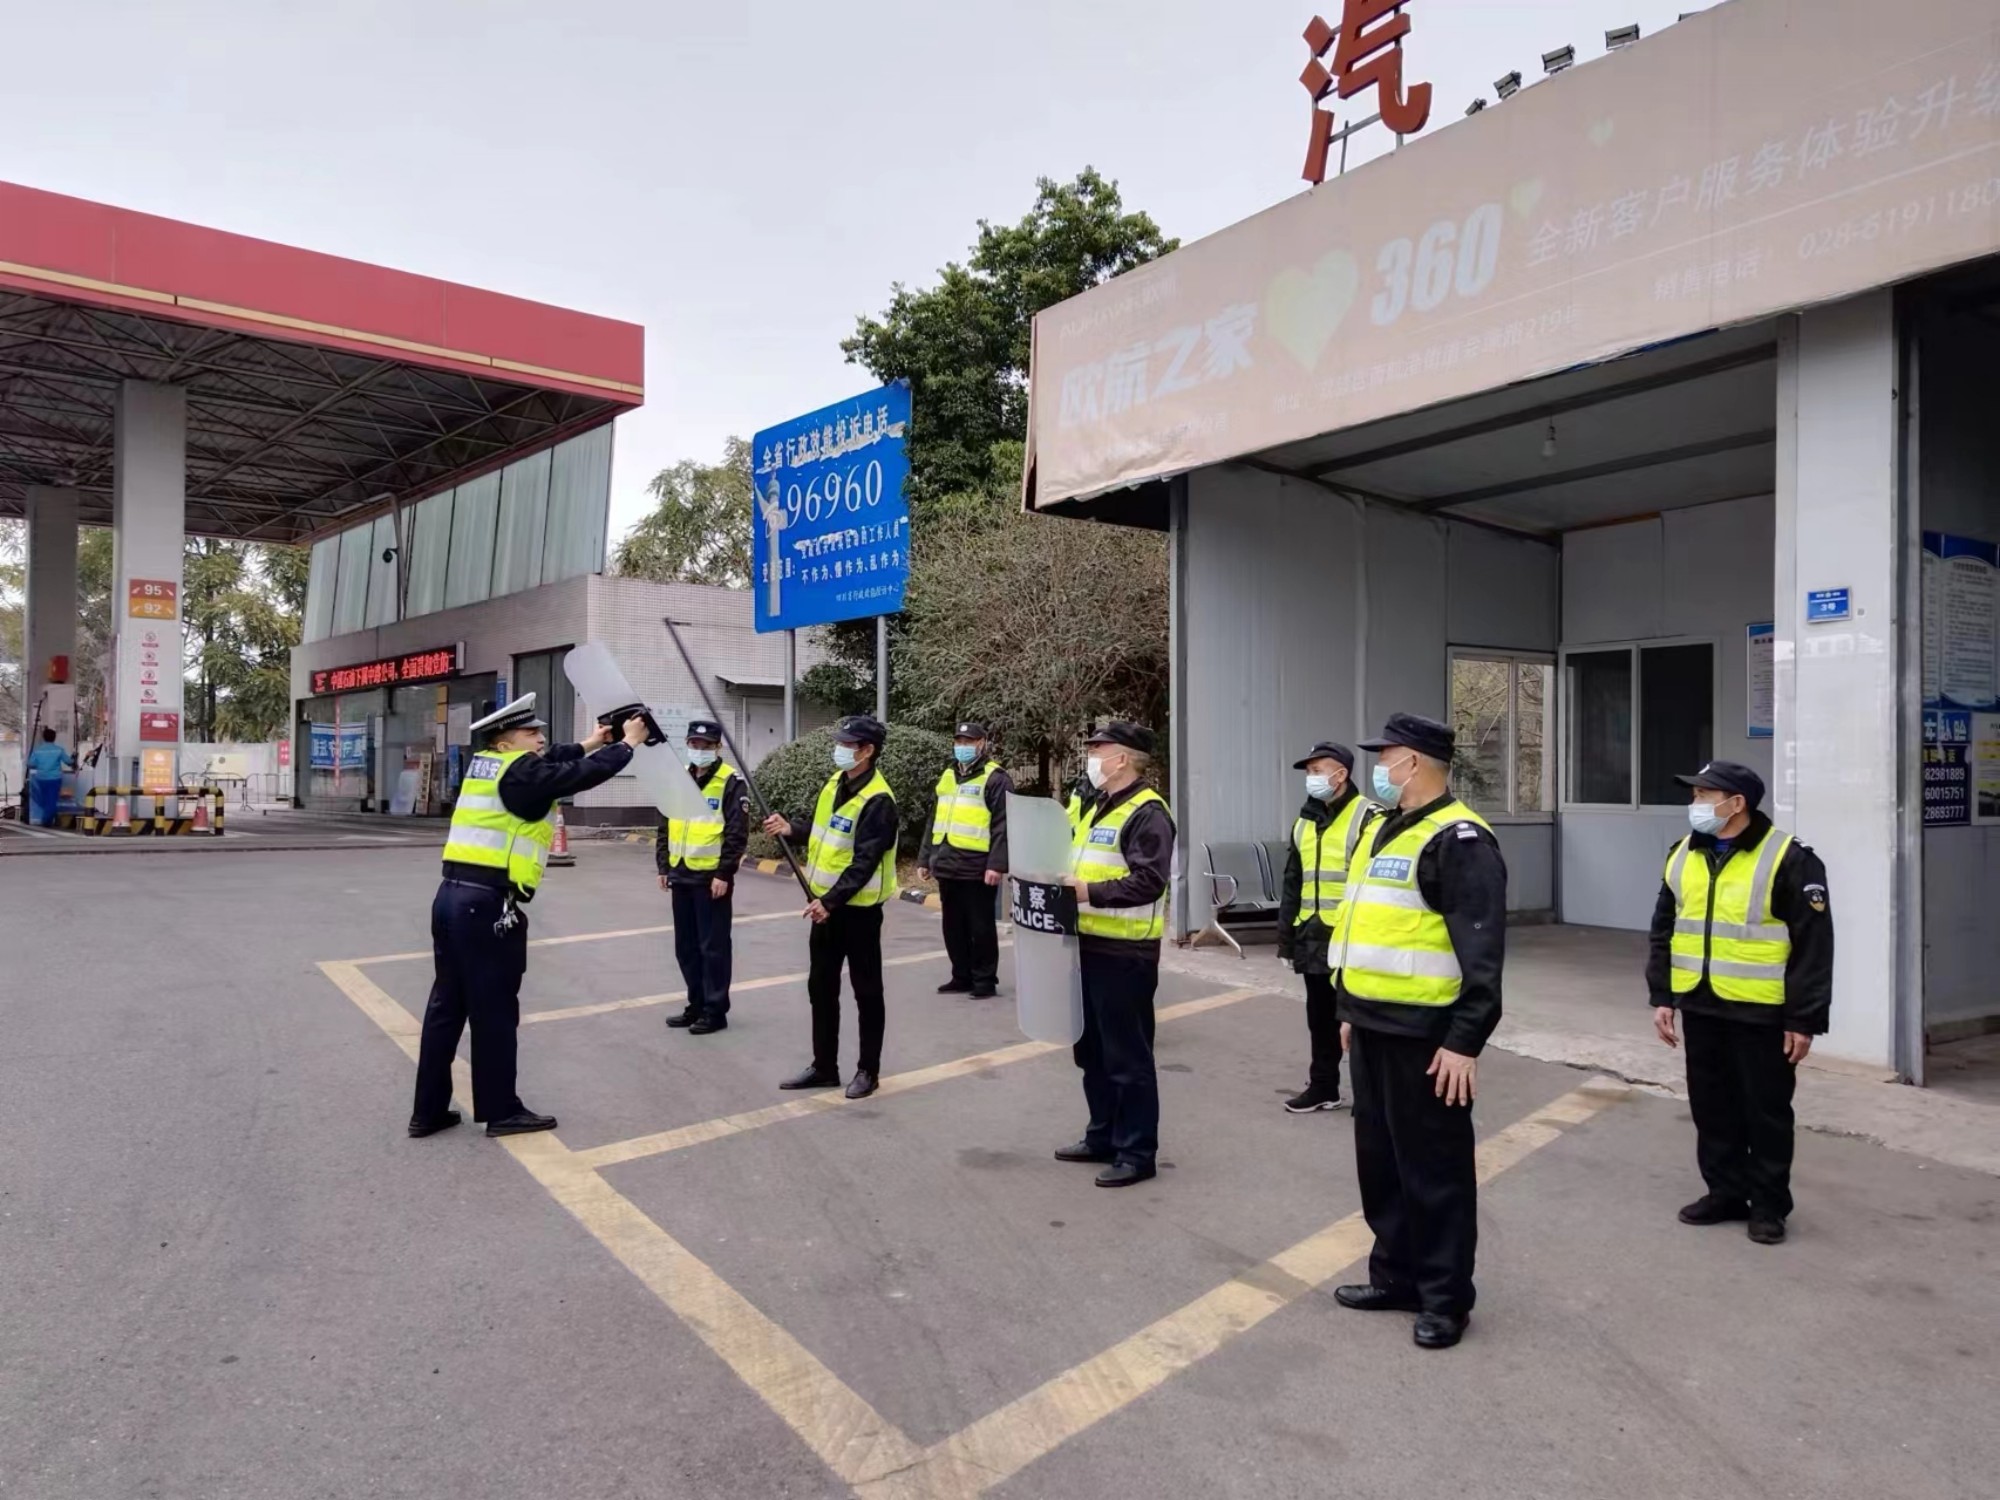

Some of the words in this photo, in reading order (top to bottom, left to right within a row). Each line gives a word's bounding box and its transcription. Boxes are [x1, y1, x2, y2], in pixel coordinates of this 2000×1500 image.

[1371, 203, 1502, 327] 360
[1058, 301, 1258, 430] 欧航之家
[787, 460, 883, 529] 96960
[144, 584, 162, 596] 95
[144, 602, 162, 614] 92
[1013, 905, 1055, 930] OLICE
